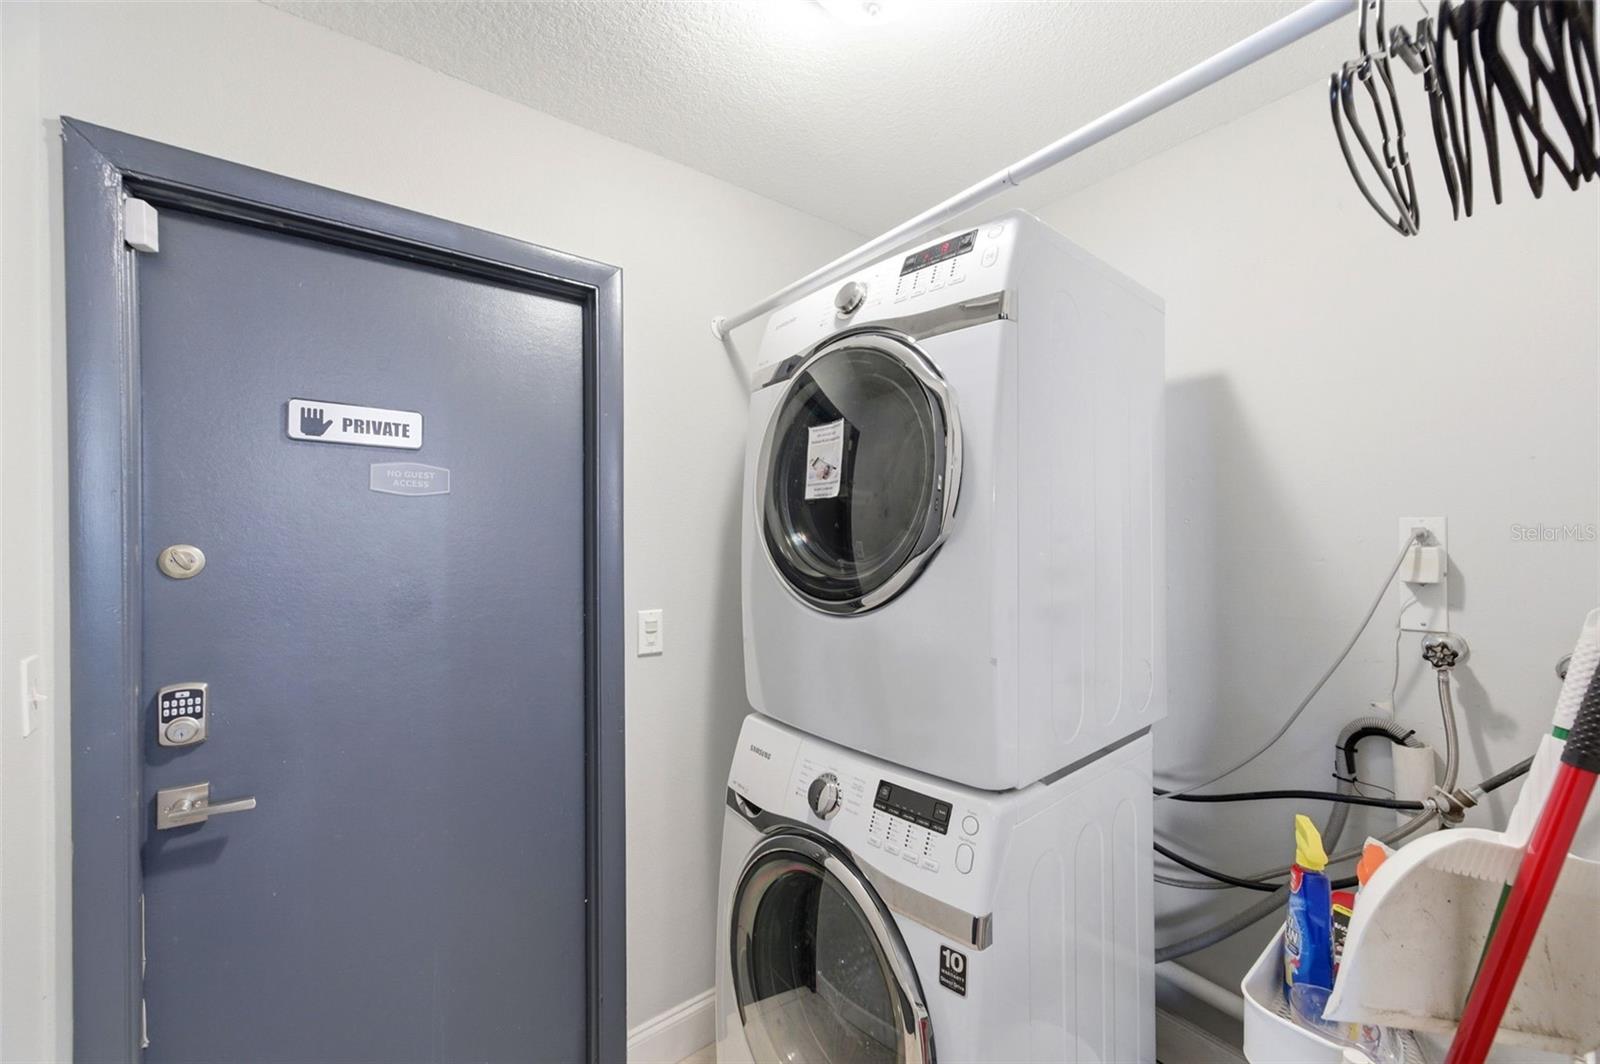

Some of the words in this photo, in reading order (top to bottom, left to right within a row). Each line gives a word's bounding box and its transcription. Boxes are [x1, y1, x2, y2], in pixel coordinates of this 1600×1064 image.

[342, 417, 410, 438] PRIVATE
[386, 469, 401, 478] NO
[404, 470, 436, 480] GUEST
[392, 479, 430, 489] ACCESS
[942, 949, 964, 973] 10
